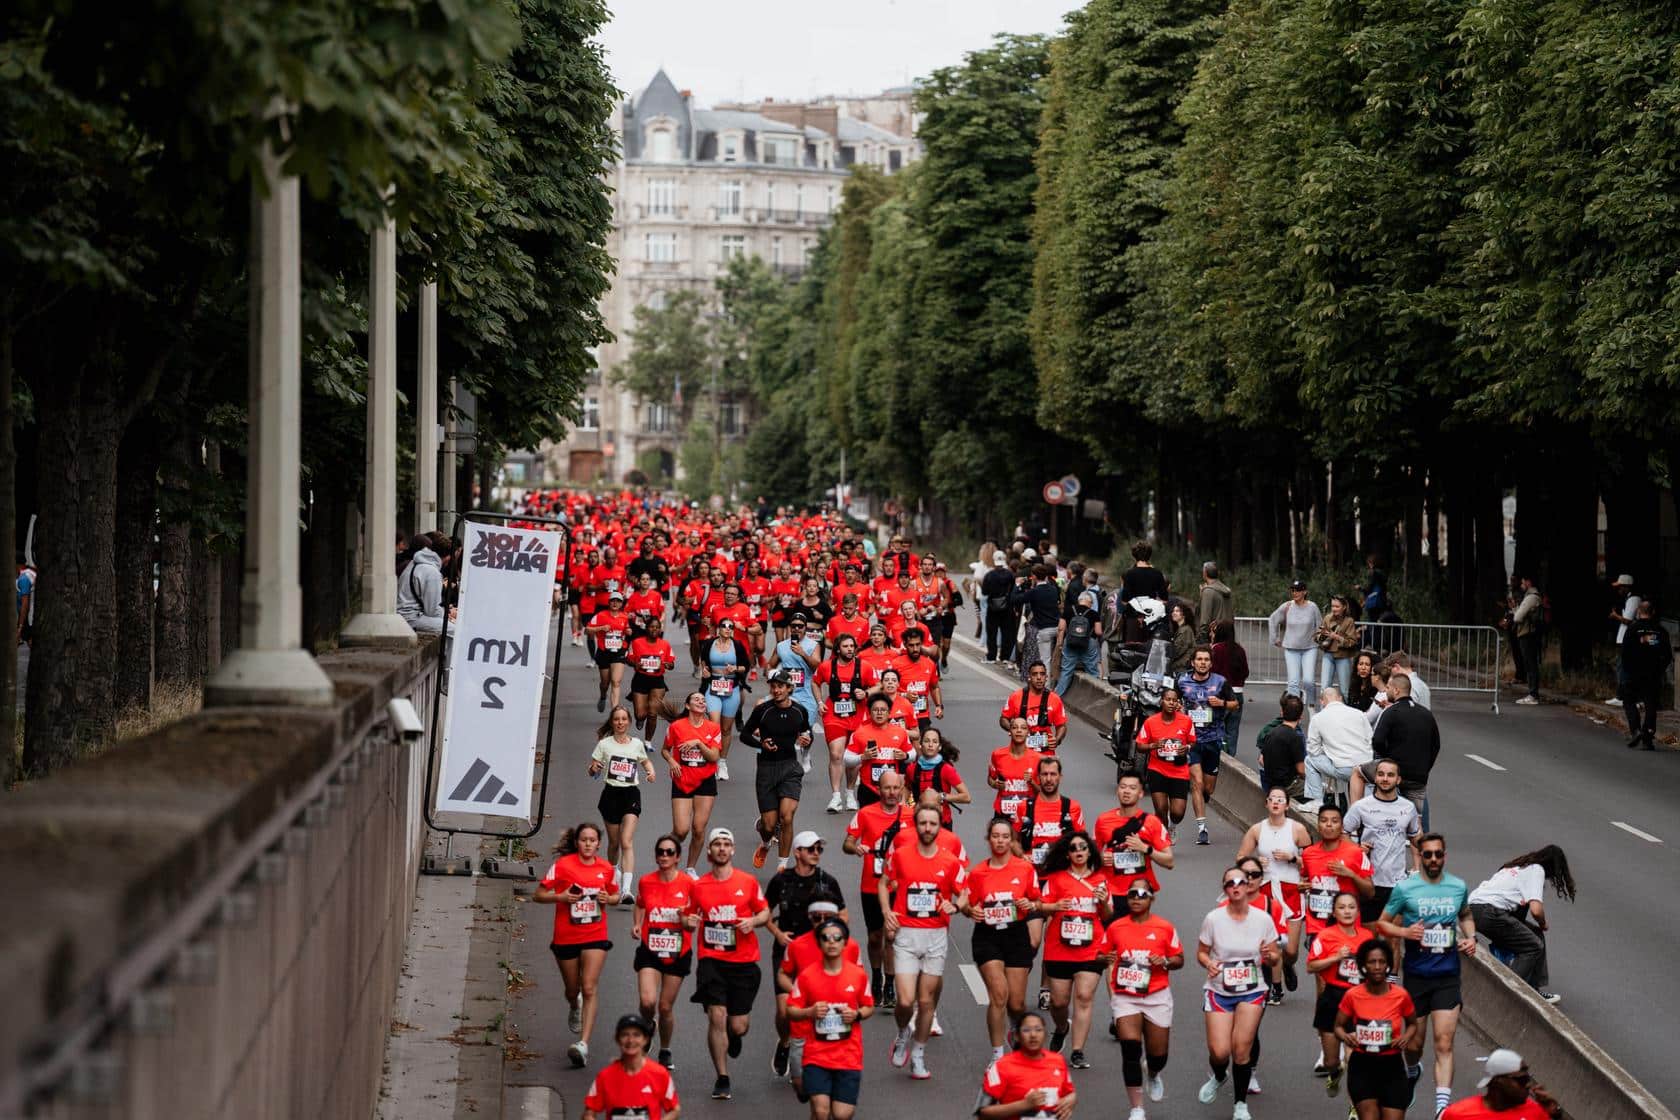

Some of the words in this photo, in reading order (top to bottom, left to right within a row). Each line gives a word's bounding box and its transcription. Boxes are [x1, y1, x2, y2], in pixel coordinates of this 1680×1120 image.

[912, 896, 932, 906] 2206
[1418, 904, 1456, 917] RATP
[651, 937, 676, 948] 35573
[1424, 932, 1447, 943] 31214
